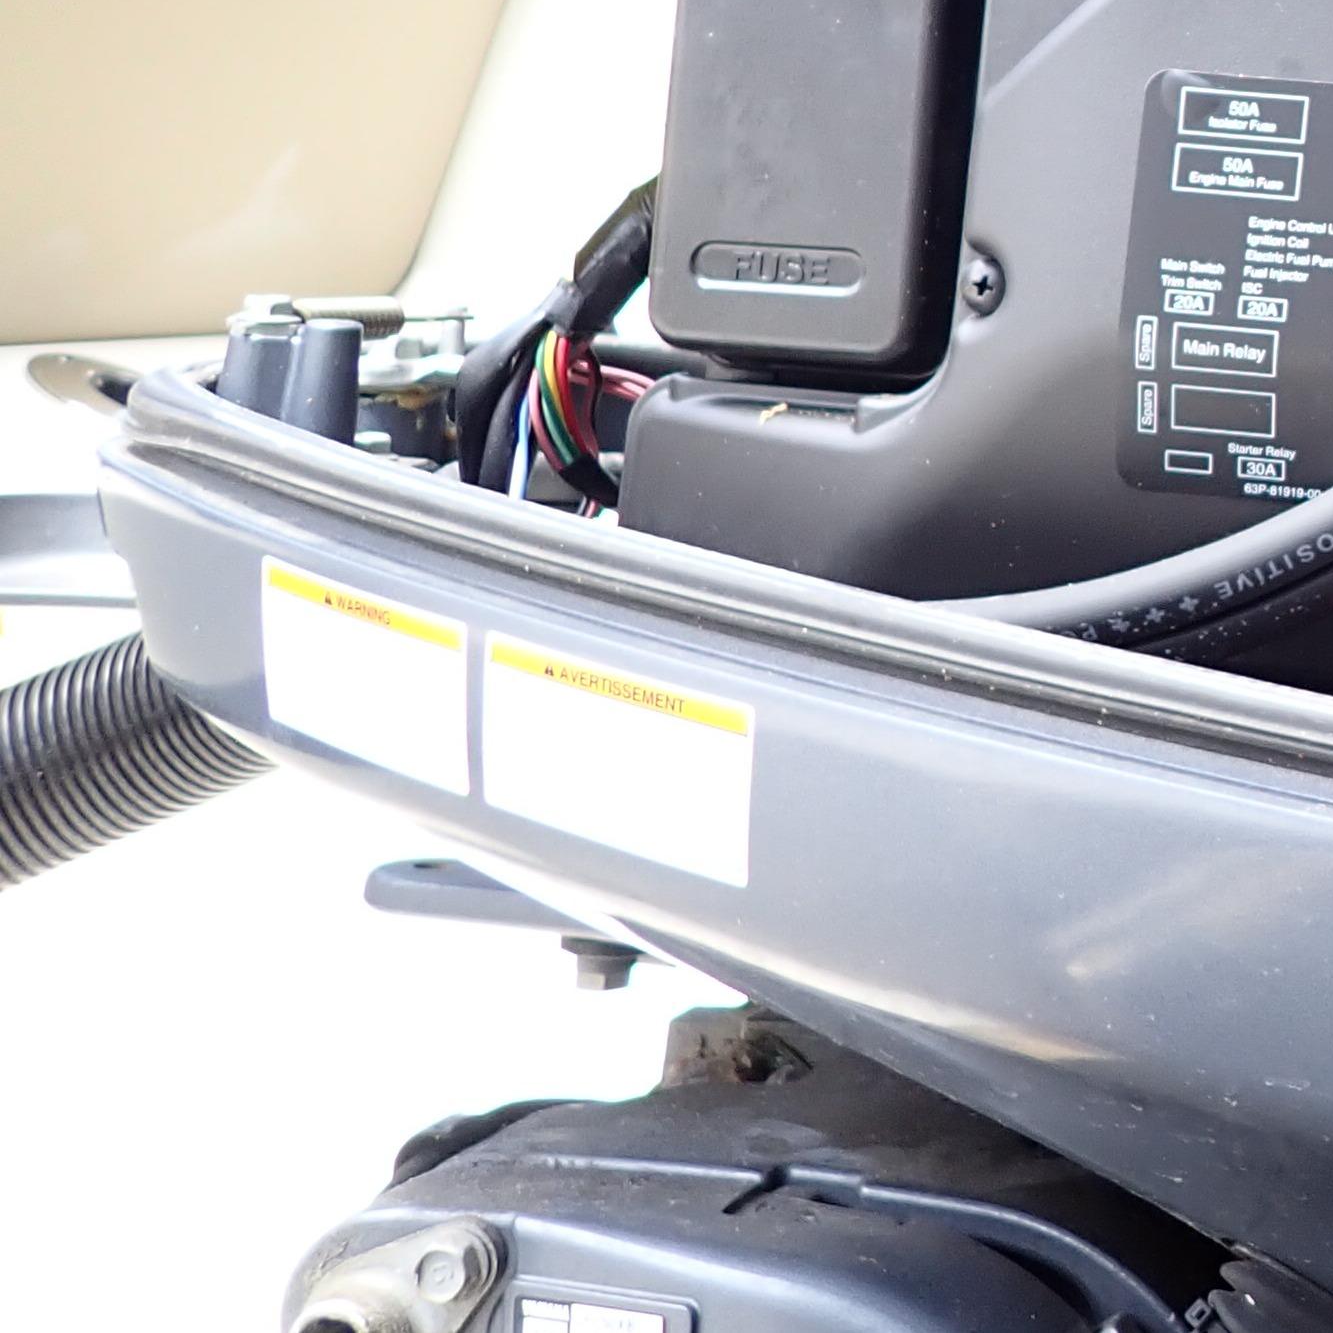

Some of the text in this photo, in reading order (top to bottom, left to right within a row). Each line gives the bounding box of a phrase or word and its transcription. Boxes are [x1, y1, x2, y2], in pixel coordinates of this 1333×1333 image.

[1228, 100, 1260, 117] 50A
[1249, 119, 1277, 133] Fuse
[1222, 157, 1254, 174] 50A
[1189, 171, 1284, 191] Engine Main Fuse
[1248, 216, 1286, 231] Engine
[1288, 219, 1326, 234] Control
[1247, 233, 1310, 249] Ignition Coil
[1245, 249, 1284, 263] Electric
[1286, 253, 1311, 266] Fuel
[732, 250, 829, 286] FUSE
[1161, 258, 1226, 275] Main Switch
[1243, 266, 1309, 282] Fuel Injector
[1161, 274, 1222, 291] Trim Switch
[1173, 295, 1205, 311] 20A
[1247, 302, 1278, 318] 20A
[1139, 323, 1151, 362] Spare
[1183, 339, 1266, 364] Main Relay
[1141, 389, 1152, 426] Spare
[1228, 443, 1296, 460] Starter Relay
[1246, 462, 1277, 477] 30A
[335, 593, 391, 626] WARNING
[559, 665, 686, 713] AVERTISSEMENT
